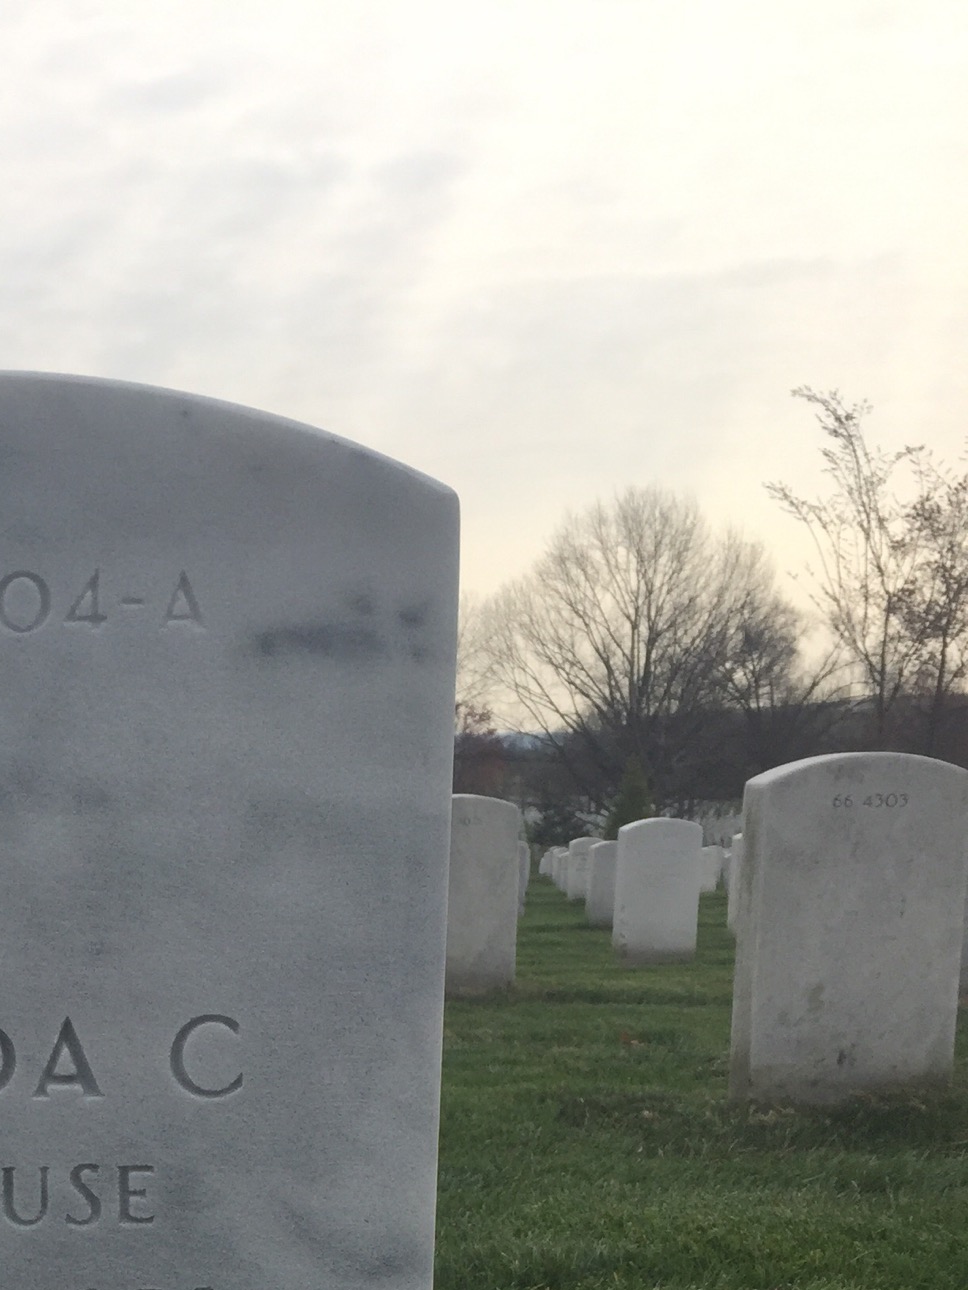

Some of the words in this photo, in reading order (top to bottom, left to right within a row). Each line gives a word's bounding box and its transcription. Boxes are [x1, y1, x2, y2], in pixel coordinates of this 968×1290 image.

[832, 793, 854, 808] 66
[862, 793, 909, 808] 4303
[169, 1013, 244, 1098] C
